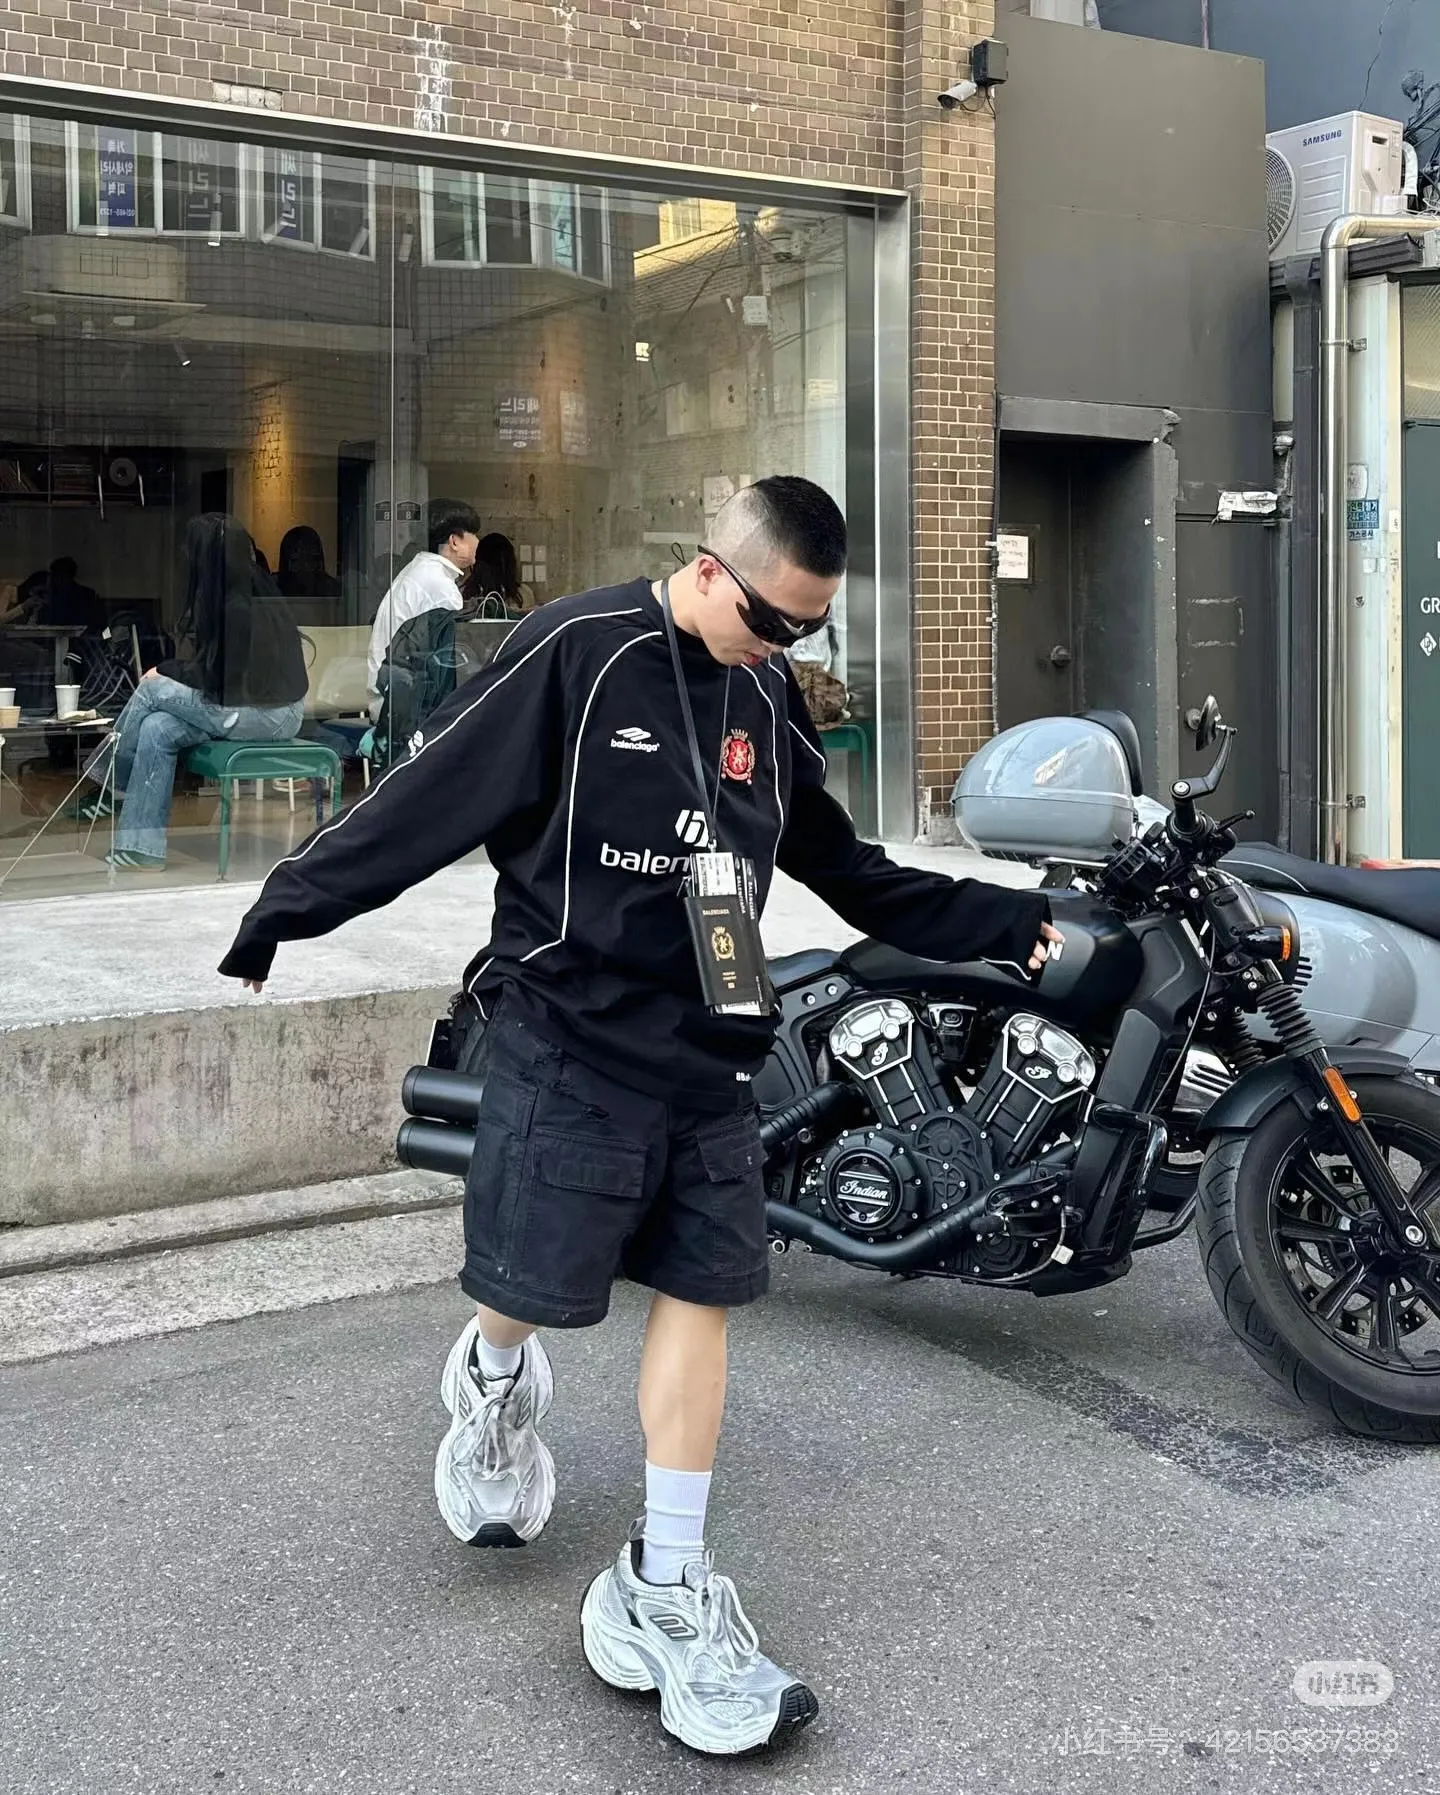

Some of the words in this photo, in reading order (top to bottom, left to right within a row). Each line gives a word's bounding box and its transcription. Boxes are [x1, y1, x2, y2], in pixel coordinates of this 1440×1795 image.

[1303, 130, 1342, 147] SAMSUNG
[611, 738, 658, 753] balenciaga
[840, 1180, 888, 1199] Indian
